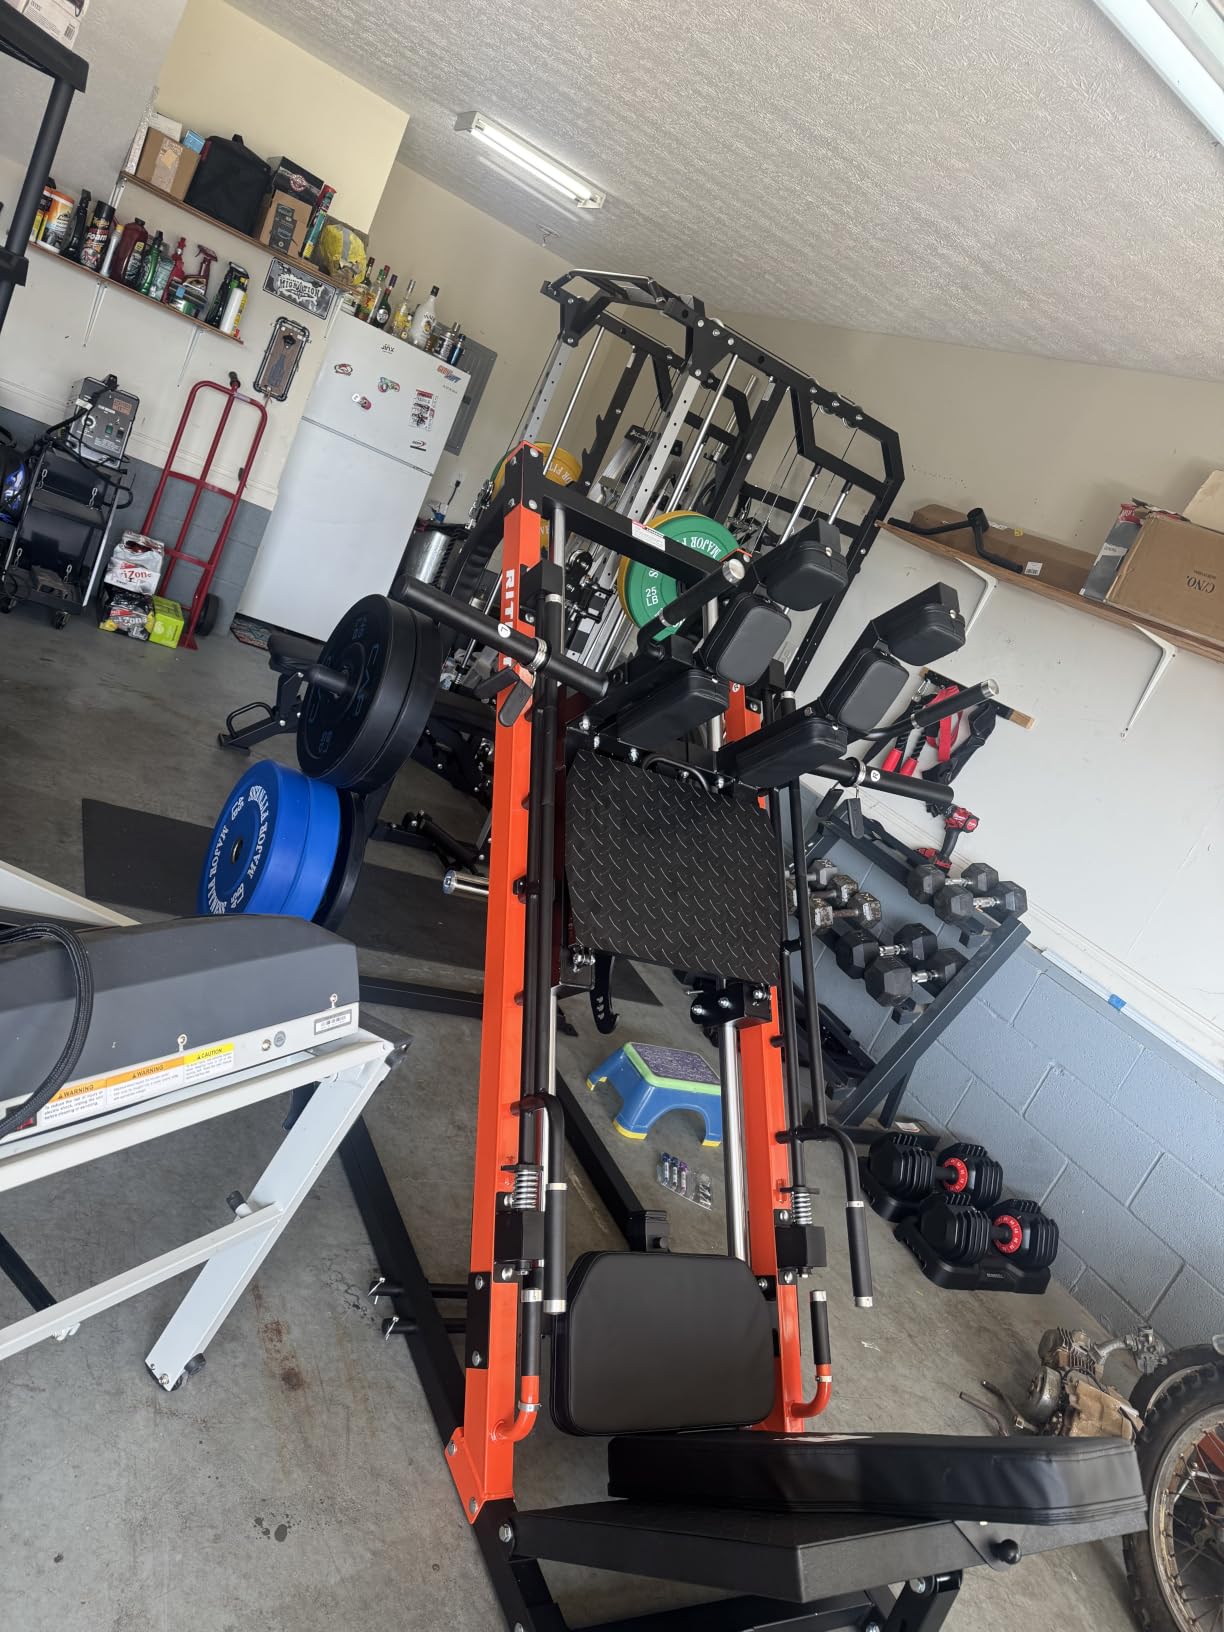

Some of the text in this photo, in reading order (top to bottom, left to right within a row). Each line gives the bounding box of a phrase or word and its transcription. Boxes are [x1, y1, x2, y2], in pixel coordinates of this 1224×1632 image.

[690, 536, 722, 559] MAJOR
[645, 586, 657, 598] 25
[645, 595, 659, 607] LB
[209, 824, 229, 878] MAJOR
[247, 821, 268, 879] MAJOR
[200, 1047, 223, 1060] CAUTION
[136, 1064, 164, 1078] WARNING
[63, 1085, 95, 1098] WARNING
